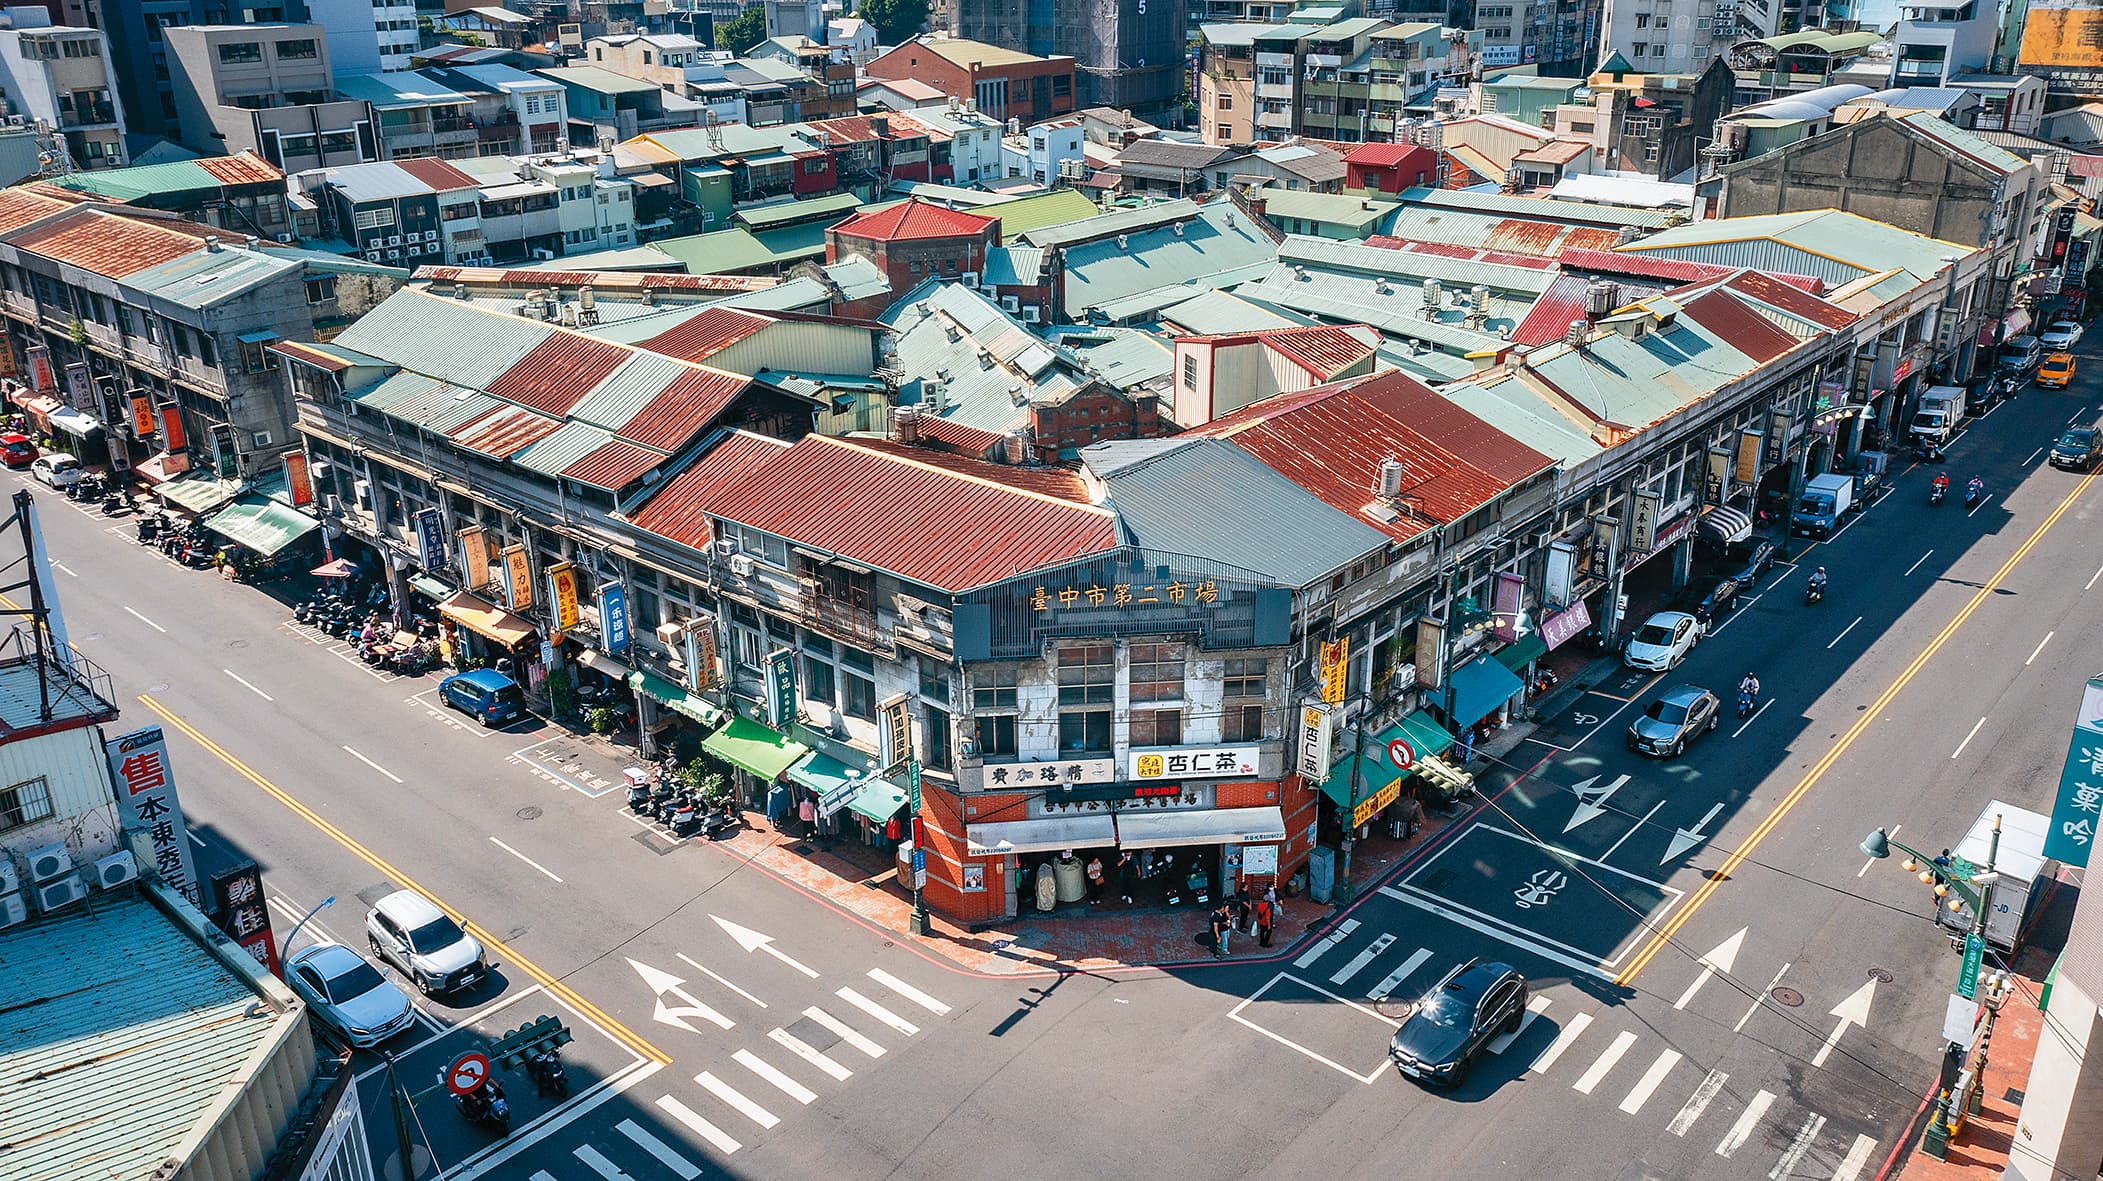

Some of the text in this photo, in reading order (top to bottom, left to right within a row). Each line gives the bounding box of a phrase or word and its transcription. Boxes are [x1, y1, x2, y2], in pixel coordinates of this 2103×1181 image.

[1635, 499, 1649, 547] 永泰商行
[1030, 580, 1219, 611] 臺中市第二市場
[1168, 752, 1237, 772] 杏仁茶
[1304, 726, 1319, 773] 杏仁茶
[120, 751, 165, 796] 售
